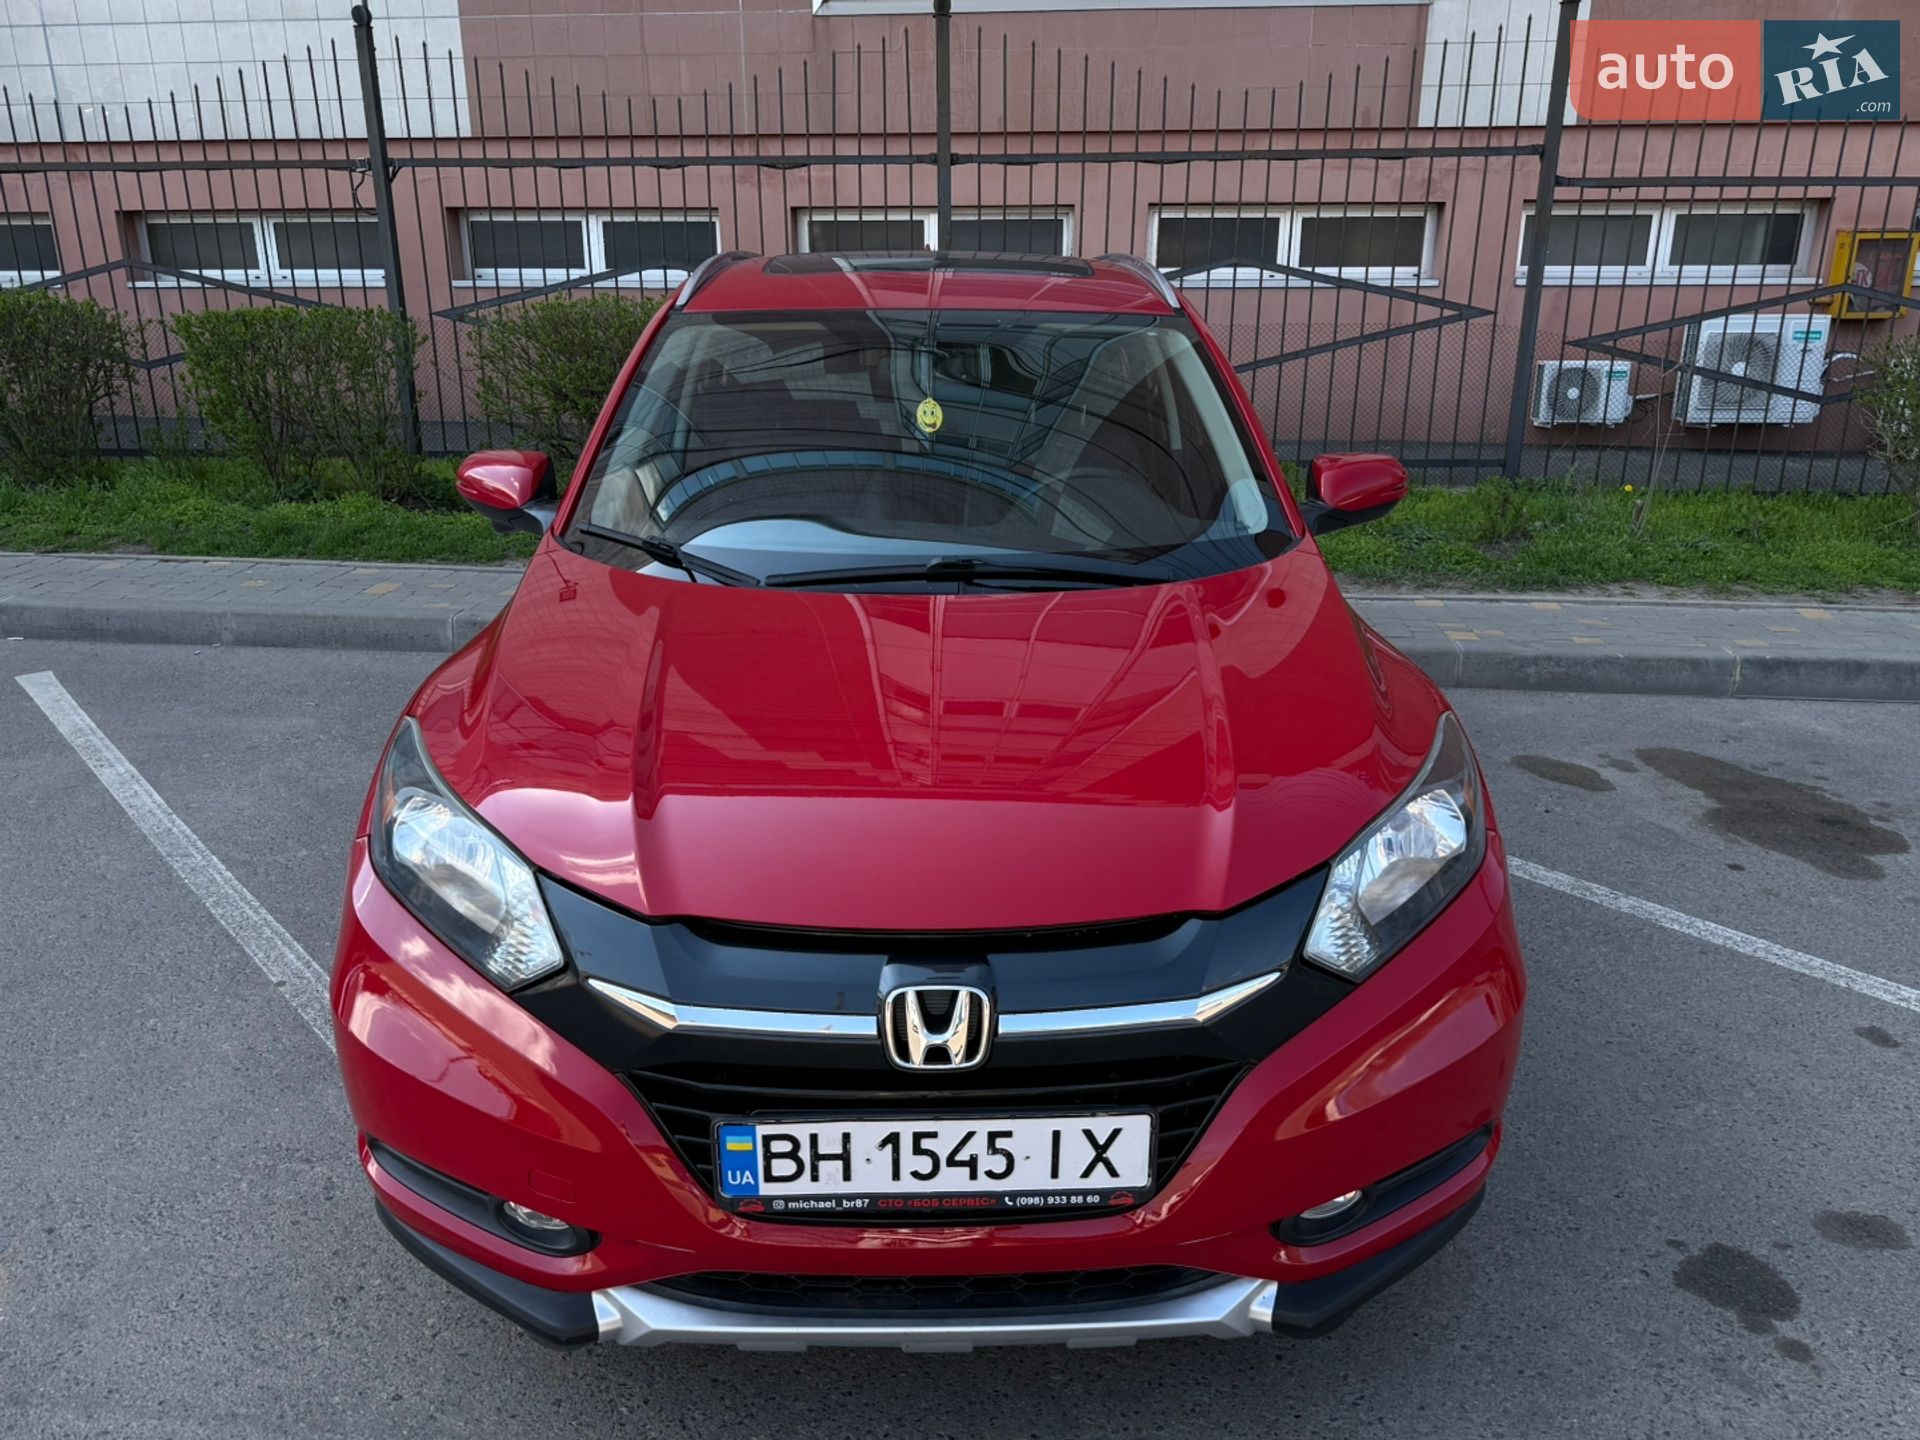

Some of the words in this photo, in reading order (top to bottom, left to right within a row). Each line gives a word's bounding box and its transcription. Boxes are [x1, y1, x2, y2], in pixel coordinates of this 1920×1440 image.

[761, 1131, 852, 1184] BH
[875, 1129, 1016, 1182] 1545
[1049, 1127, 1124, 1180] IX
[727, 1170, 756, 1186] UA
[787, 1198, 870, 1211] michael_br87
[1015, 1195, 1045, 1207] (098)
[1046, 1195, 1068, 1205] 933
[1069, 1194, 1085, 1204] 88
[1086, 1194, 1101, 1204] 60
